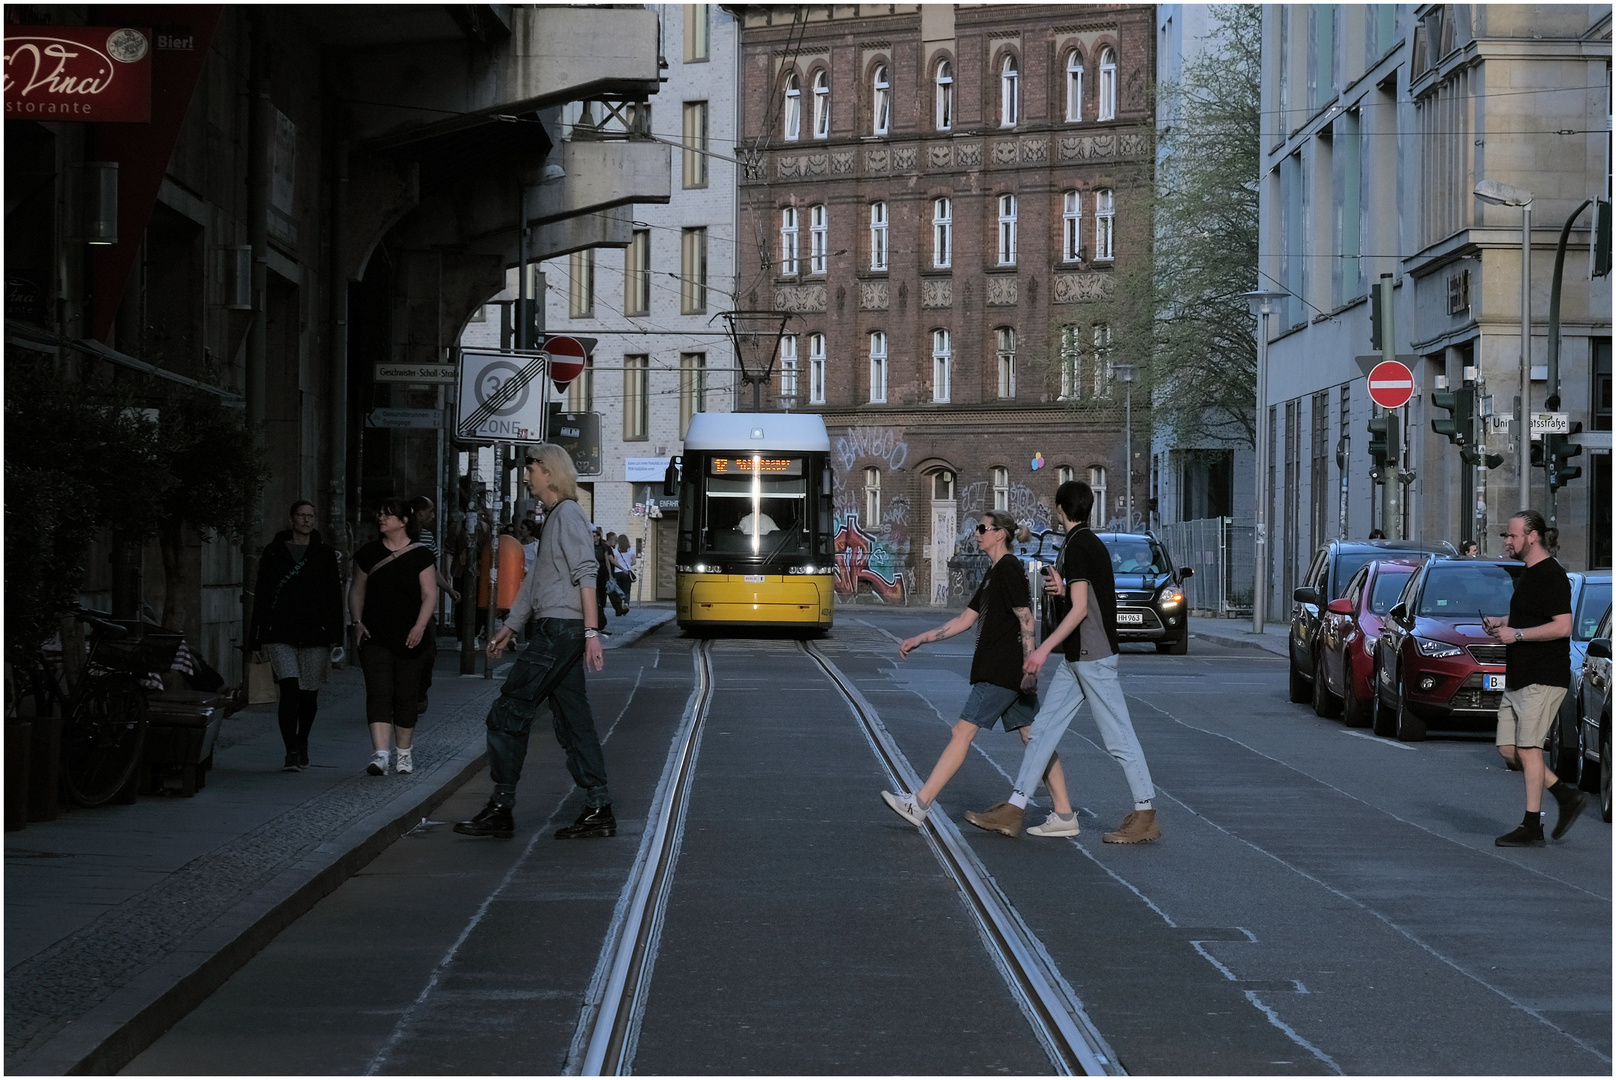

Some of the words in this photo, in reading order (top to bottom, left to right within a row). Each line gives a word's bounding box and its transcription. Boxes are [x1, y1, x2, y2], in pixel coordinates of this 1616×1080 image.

[157, 35, 194, 49] Bier!
[9, 43, 109, 97] Vinci
[6, 100, 92, 114] storante
[479, 420, 521, 435] ZONE
[1128, 614, 1140, 622] 963
[1491, 676, 1498, 688] B
